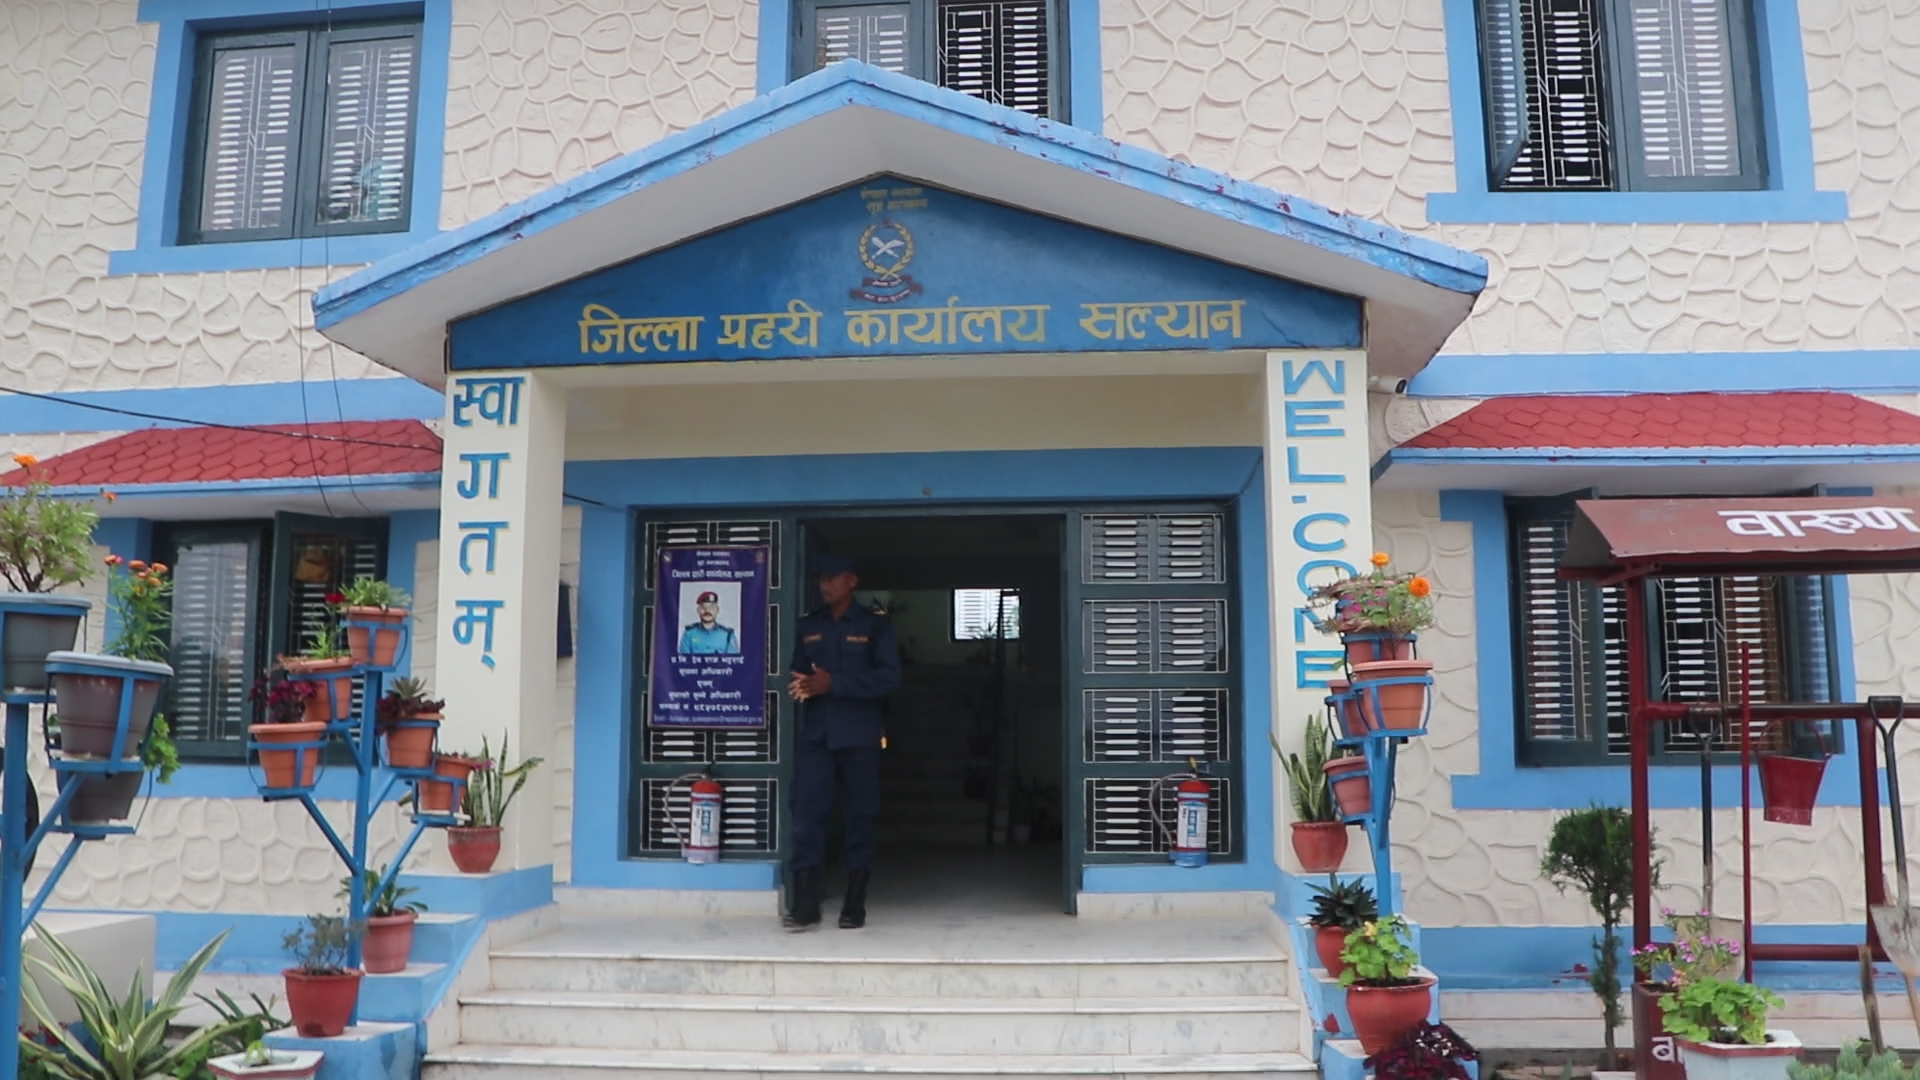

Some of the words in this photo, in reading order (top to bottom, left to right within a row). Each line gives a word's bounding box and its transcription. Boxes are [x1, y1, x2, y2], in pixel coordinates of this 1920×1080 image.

[578, 304, 704, 353] जिल्ला
[717, 299, 823, 348] प्रहरी
[844, 296, 1051, 347] कार्यालय
[1080, 300, 1246, 340] सल्यान
